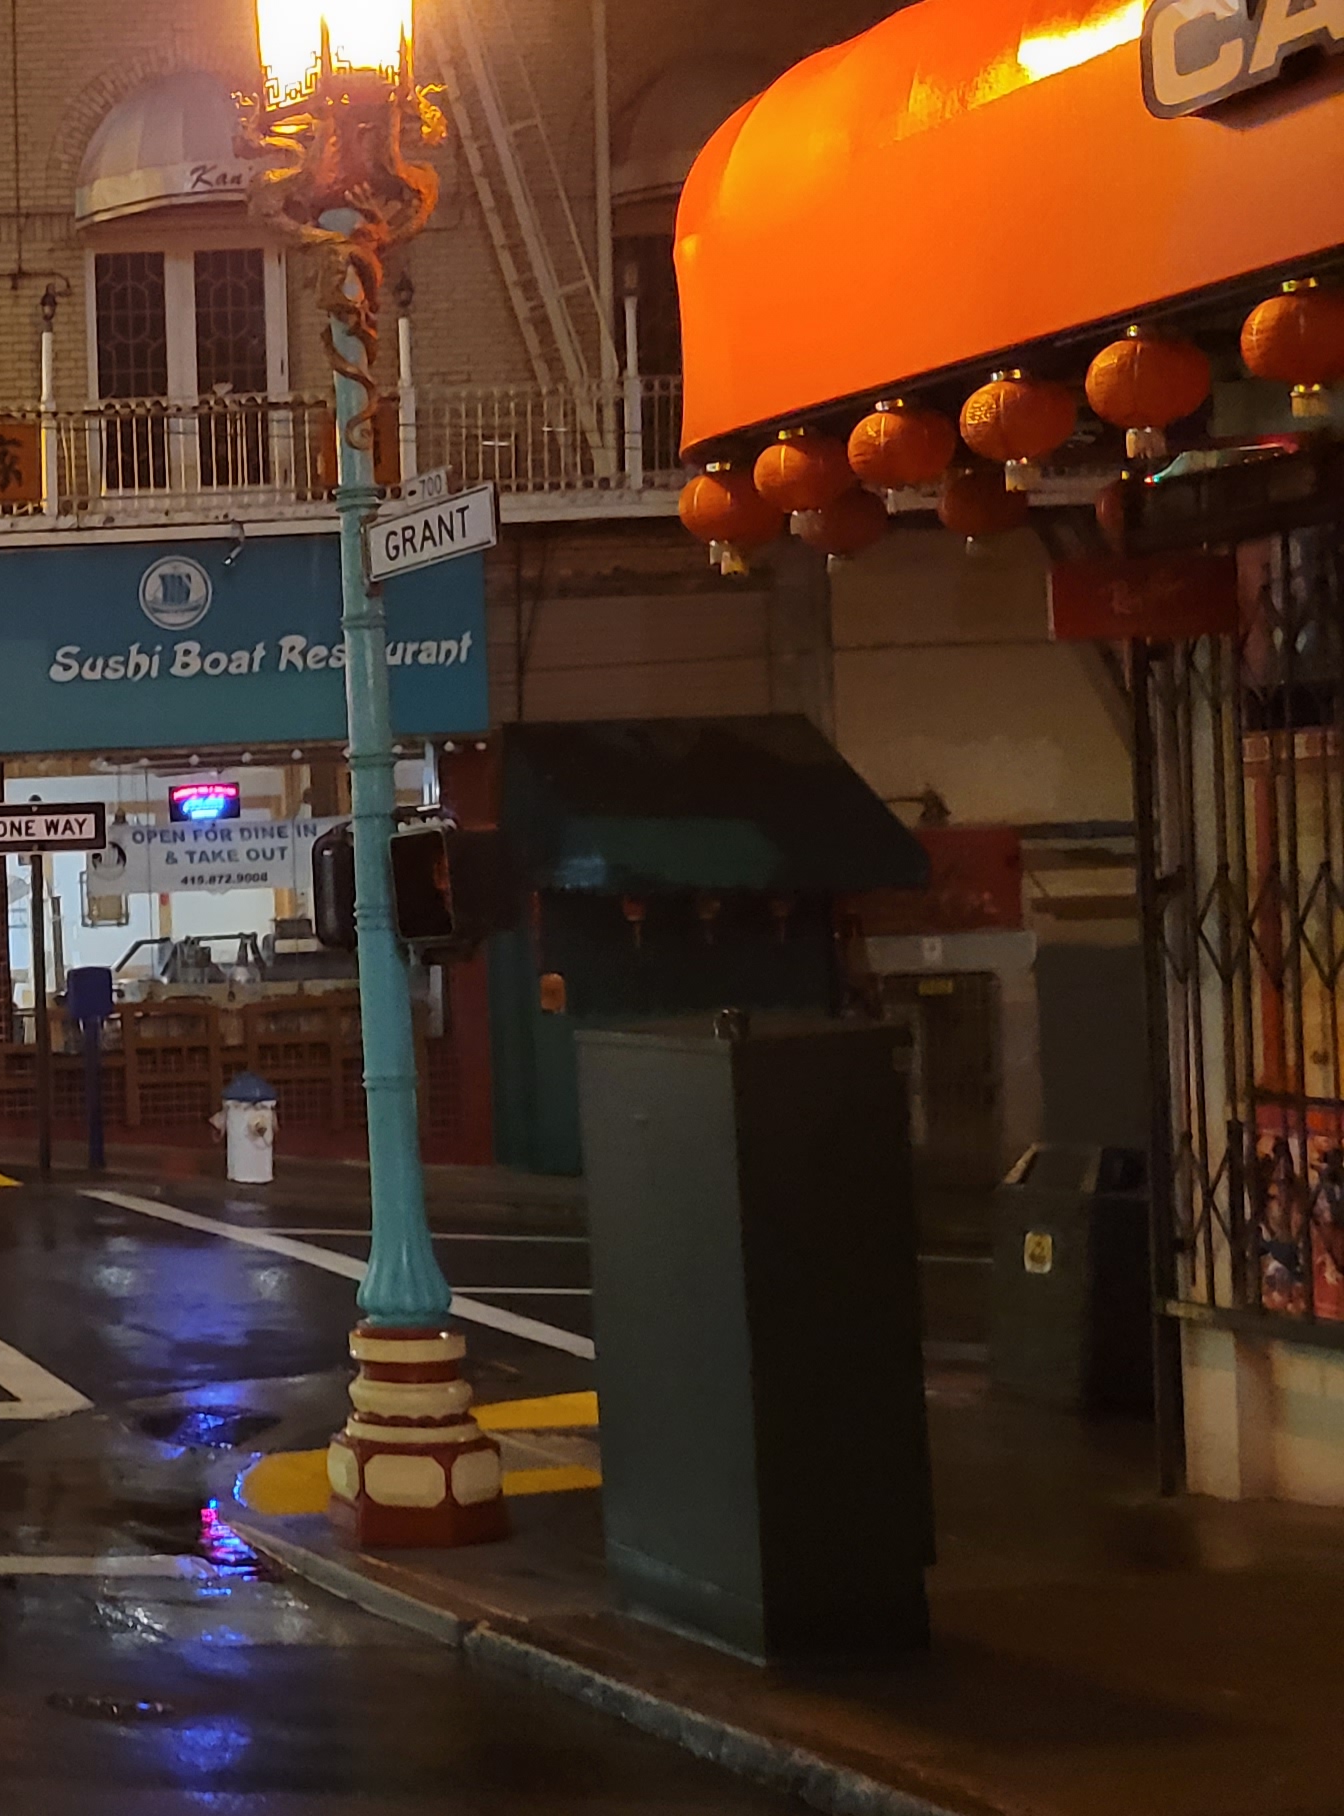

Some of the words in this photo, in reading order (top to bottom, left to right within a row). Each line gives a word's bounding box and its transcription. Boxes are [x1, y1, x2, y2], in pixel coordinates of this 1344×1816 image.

[384, 504, 470, 562] GRANT
[49, 642, 161, 683] Sushi
[169, 640, 266, 678] Boat
[278, 630, 473, 673] Resurant
[44, 817, 88, 836] WAY
[131, 829, 185, 845] OPEN
[193, 827, 232, 844] FOR
[239, 824, 289, 841] DINE
[296, 823, 318, 838] IN
[165, 850, 178, 865] &
[185, 848, 240, 864] TAKE
[245, 845, 289, 862] OUT
